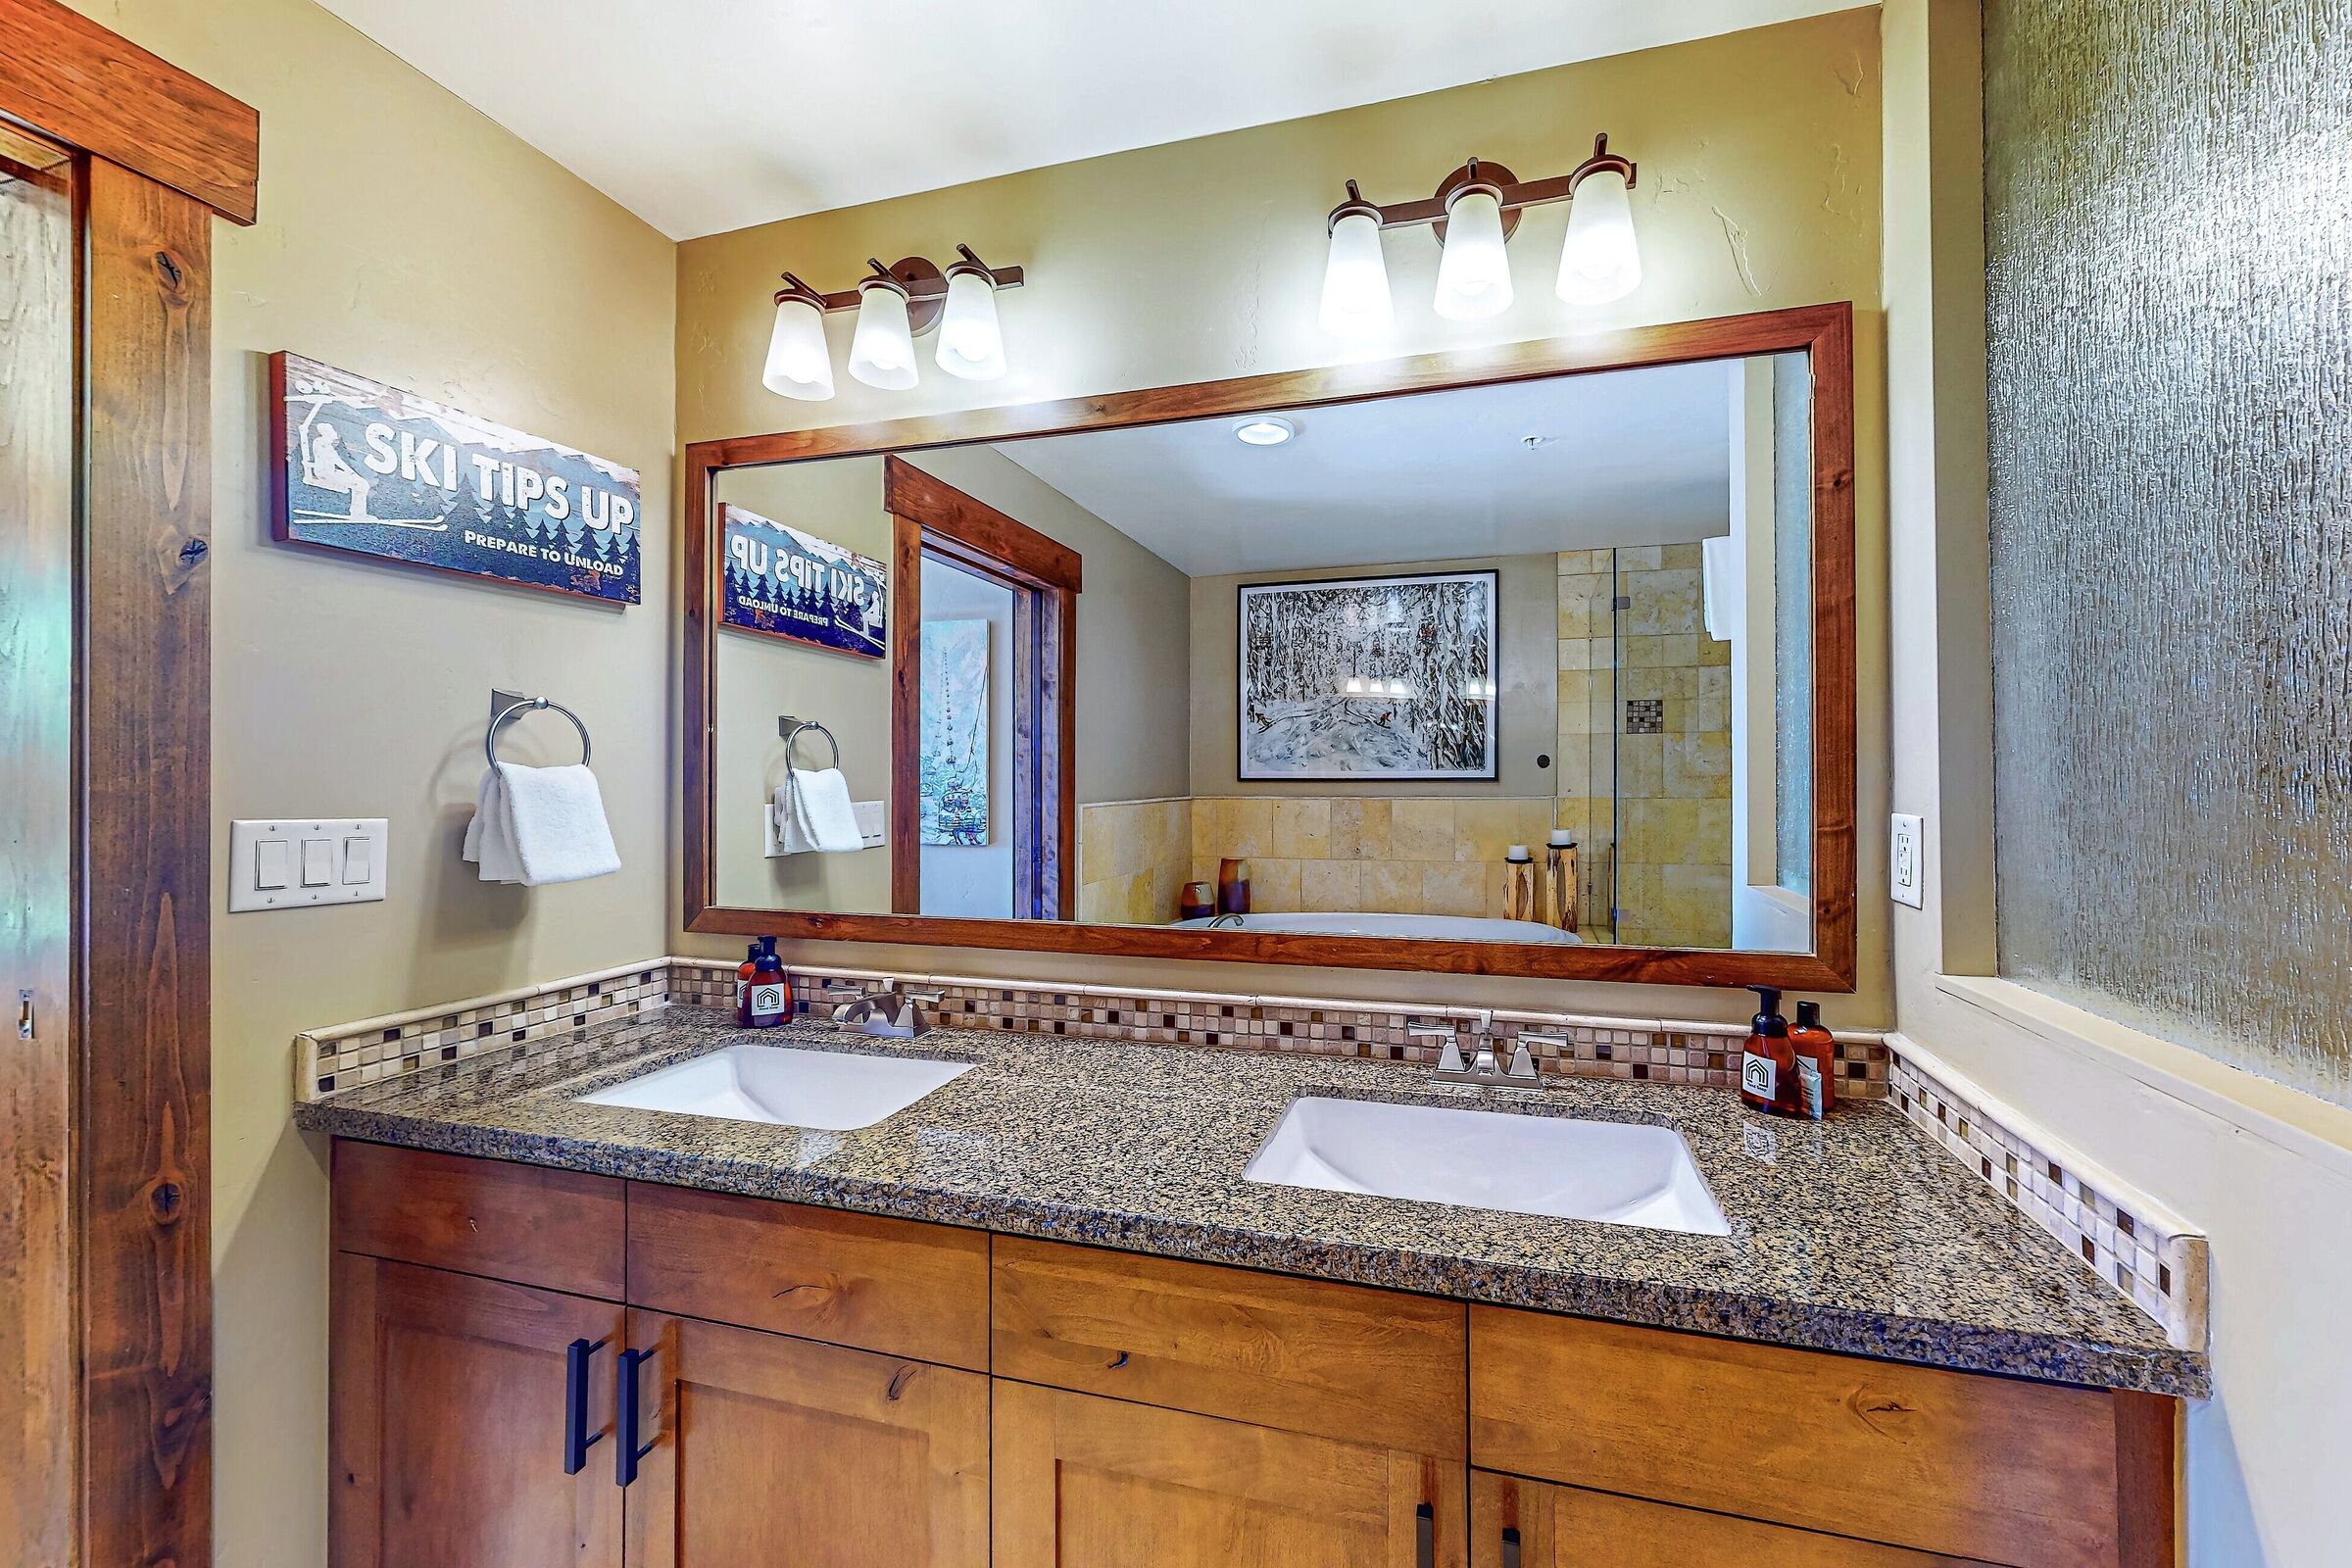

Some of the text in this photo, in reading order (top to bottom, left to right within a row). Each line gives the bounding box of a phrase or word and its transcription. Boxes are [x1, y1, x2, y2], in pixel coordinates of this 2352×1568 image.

[364, 422, 634, 535] SKI TIPS UP
[465, 530, 623, 576] PREPARE TO UNLOAD
